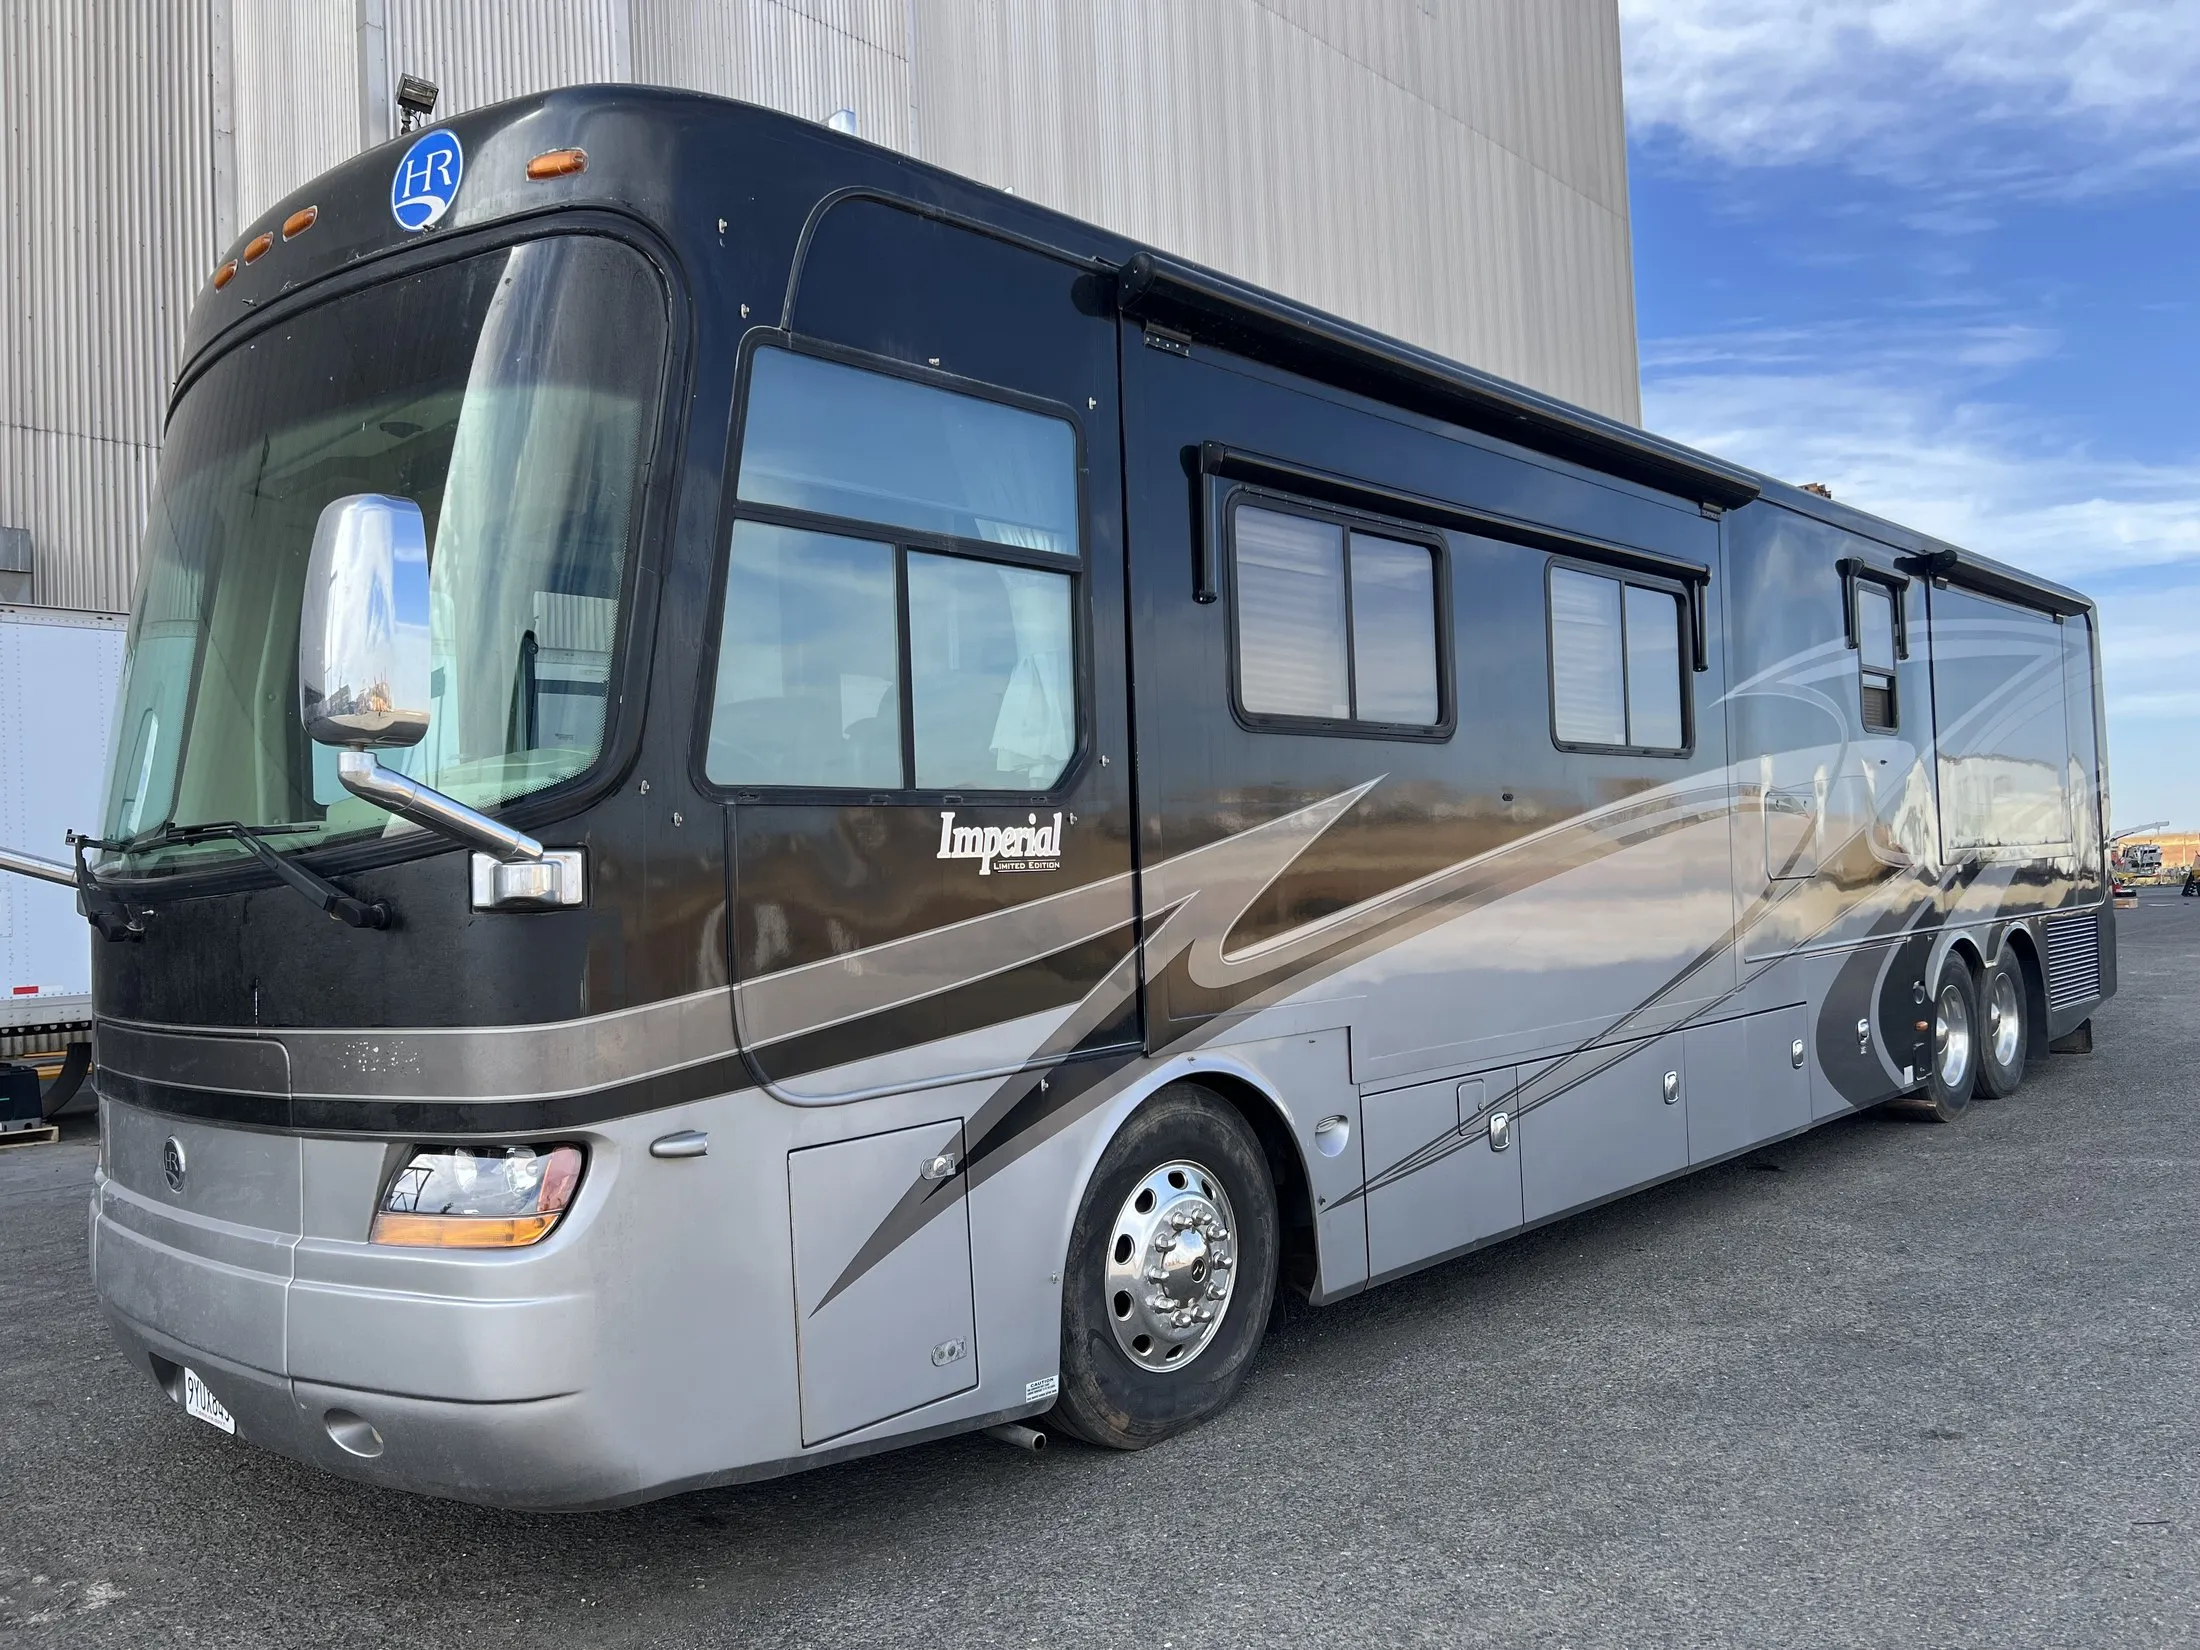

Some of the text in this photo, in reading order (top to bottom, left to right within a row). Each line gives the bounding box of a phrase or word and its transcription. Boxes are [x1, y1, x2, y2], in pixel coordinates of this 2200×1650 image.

[402, 149, 453, 198] HR
[937, 811, 1062, 875] Imperial
[993, 861, 1060, 870] LIMITED EDITION
[164, 1150, 179, 1171] HR
